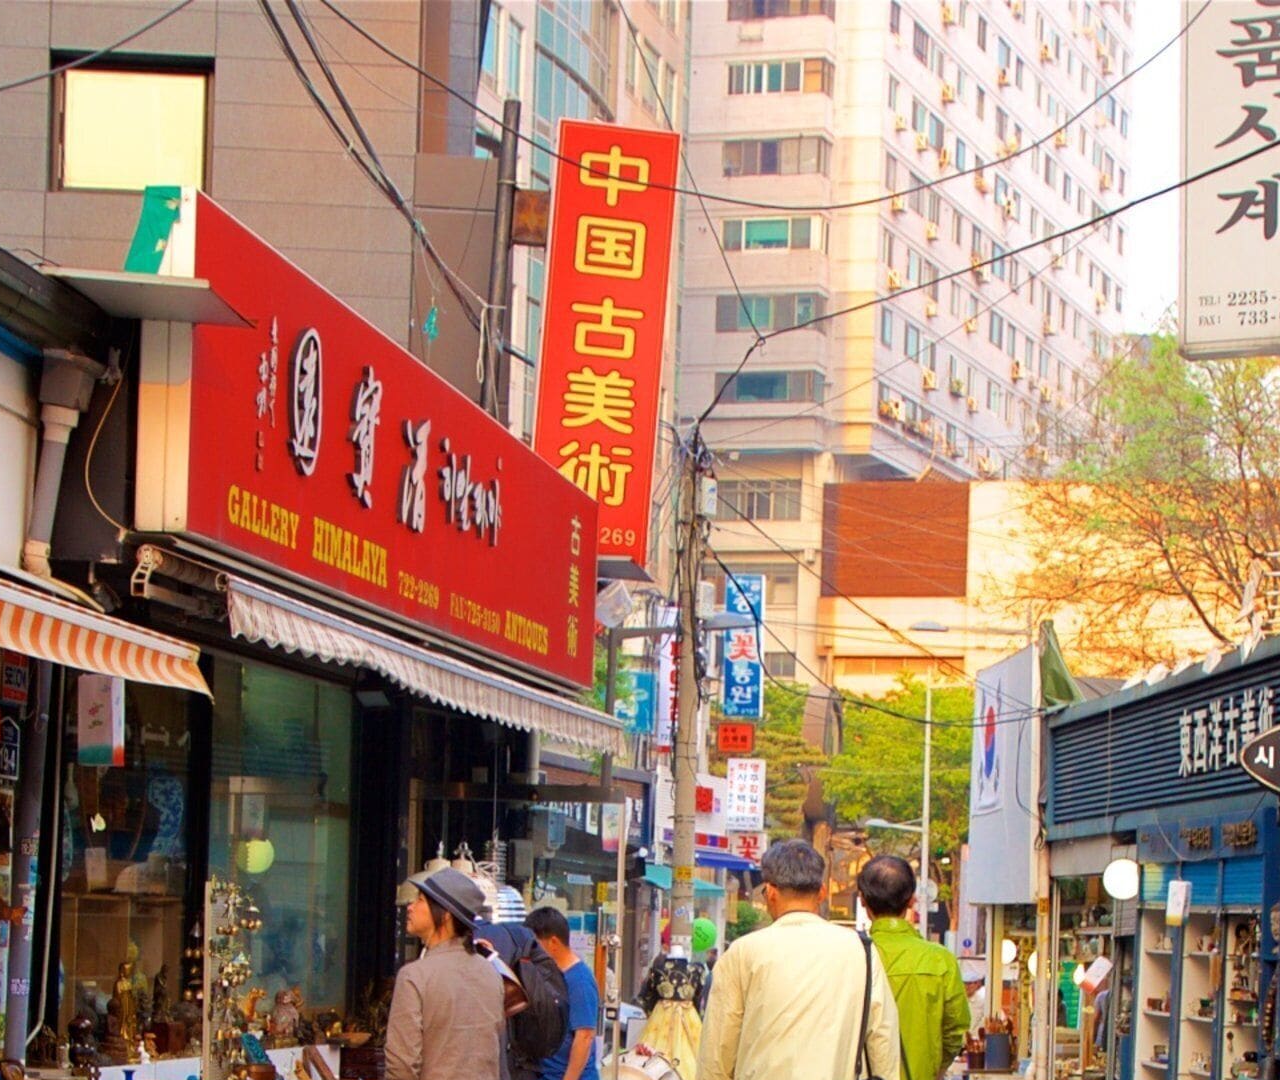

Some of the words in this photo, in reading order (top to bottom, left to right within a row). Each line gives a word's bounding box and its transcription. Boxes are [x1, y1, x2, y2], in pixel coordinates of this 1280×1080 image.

[228, 484, 299, 549] GALLERY
[313, 515, 388, 589] HIMALAYA
[504, 609, 549, 656] ANTIQUES
